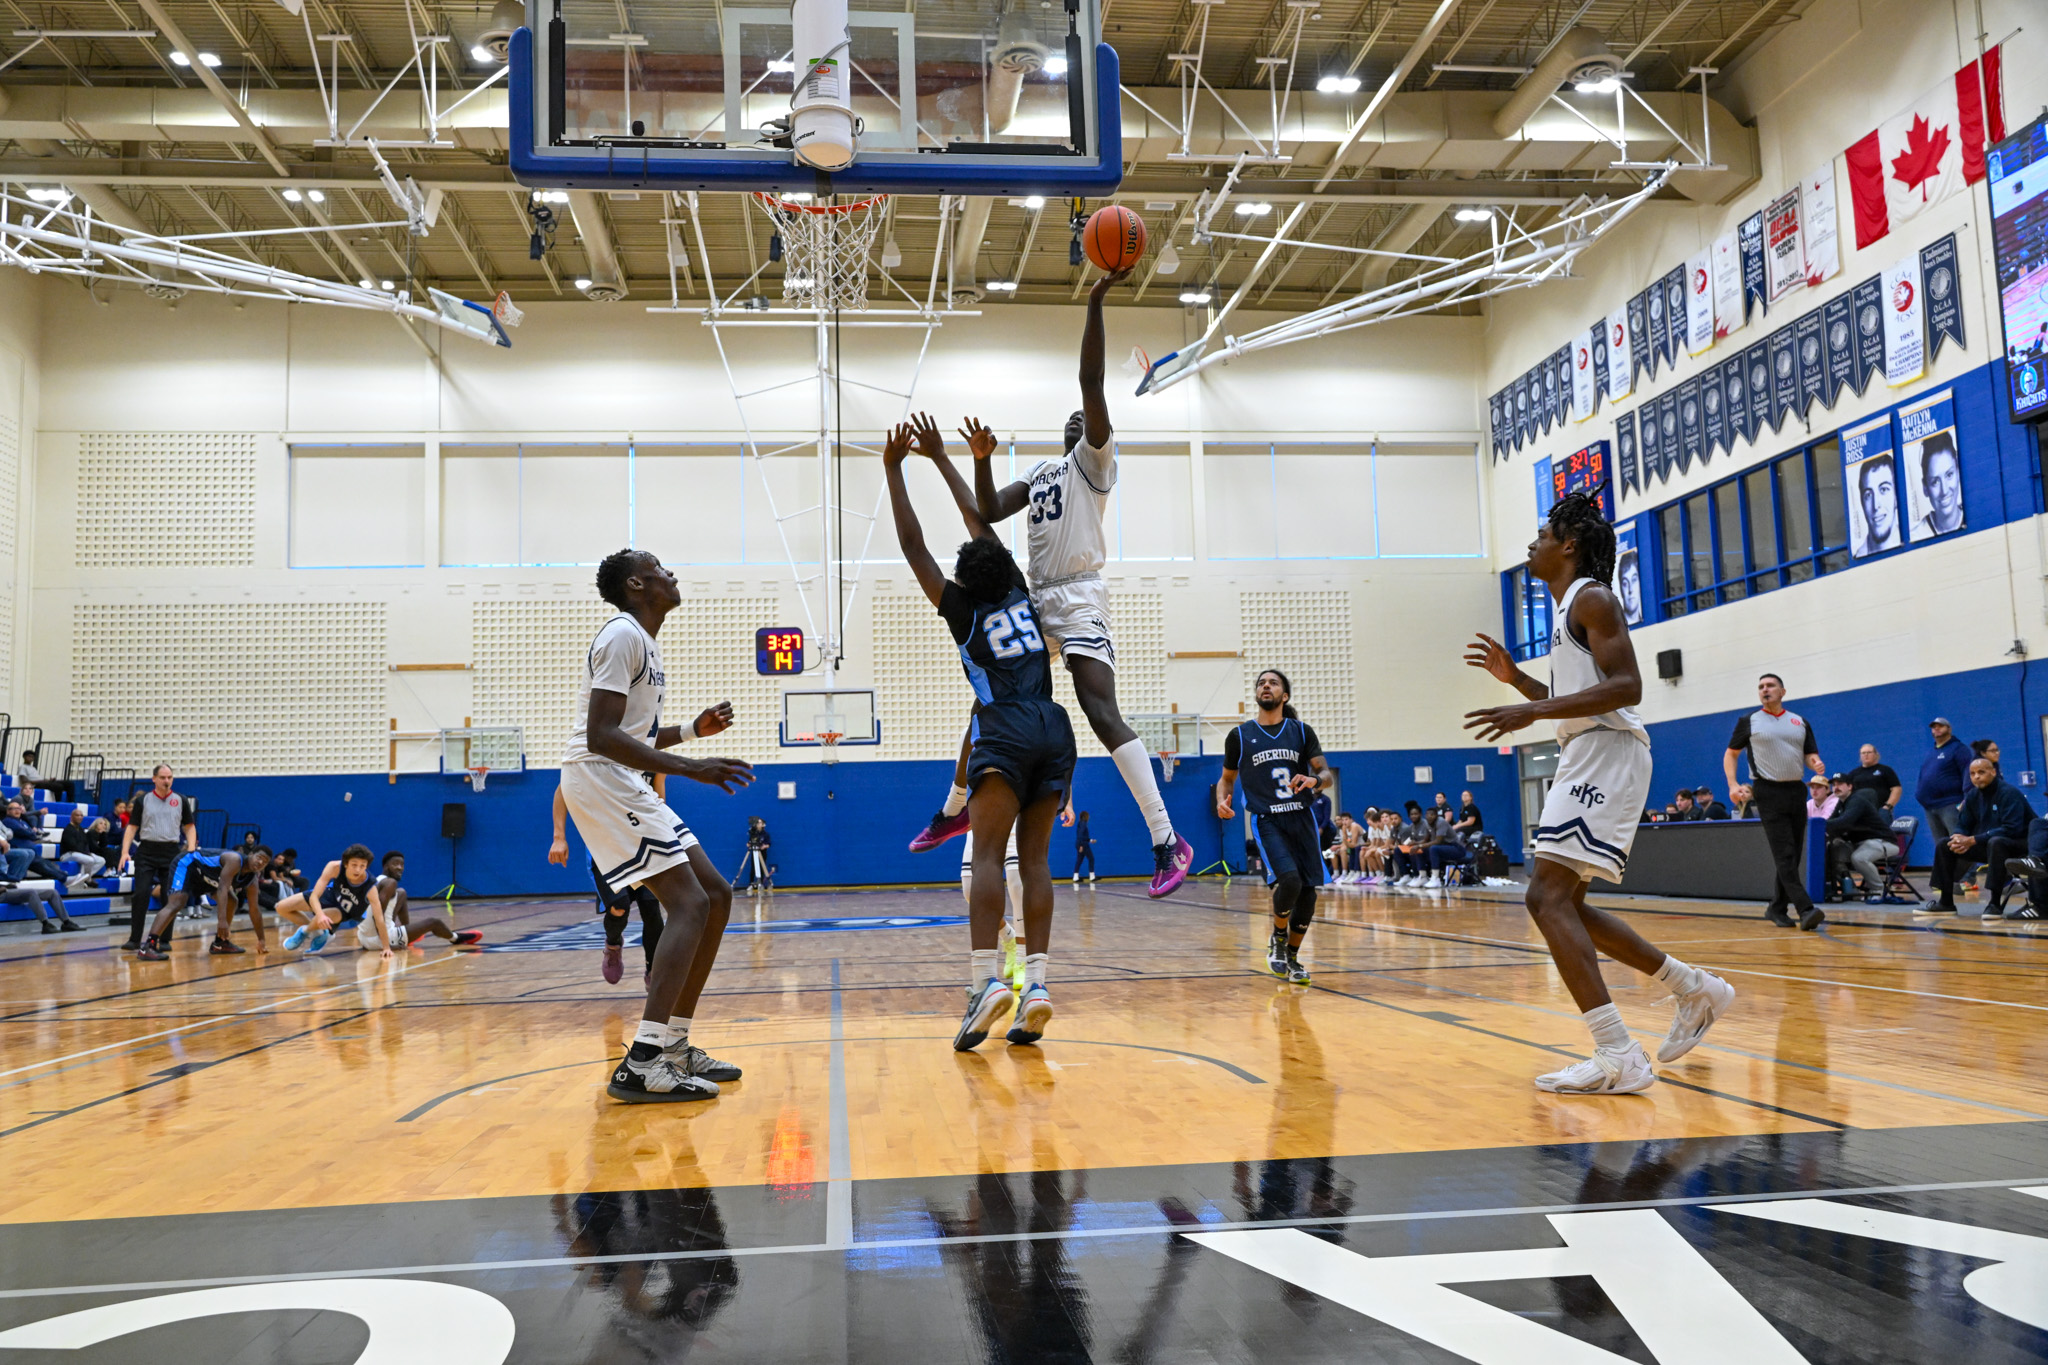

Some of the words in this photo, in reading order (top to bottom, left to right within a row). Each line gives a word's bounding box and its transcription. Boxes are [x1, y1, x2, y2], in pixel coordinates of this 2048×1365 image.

[1124, 212, 1138, 255] Wilson
[2016, 389, 2047, 410] KNIGHTS
[1901, 408, 1931, 431] KAITLYN
[1903, 419, 1937, 443] McKENNA
[1845, 434, 1867, 453] JUSTIN
[1846, 448, 1864, 464] ROSS
[1031, 483, 1063, 525] 33
[983, 600, 1044, 660] 25
[767, 634, 802, 651] 3:27
[775, 651, 793, 671] 14
[1252, 748, 1300, 766] SHERIDAN
[1271, 767, 1294, 799] 3
[626, 811, 640, 827] 5
